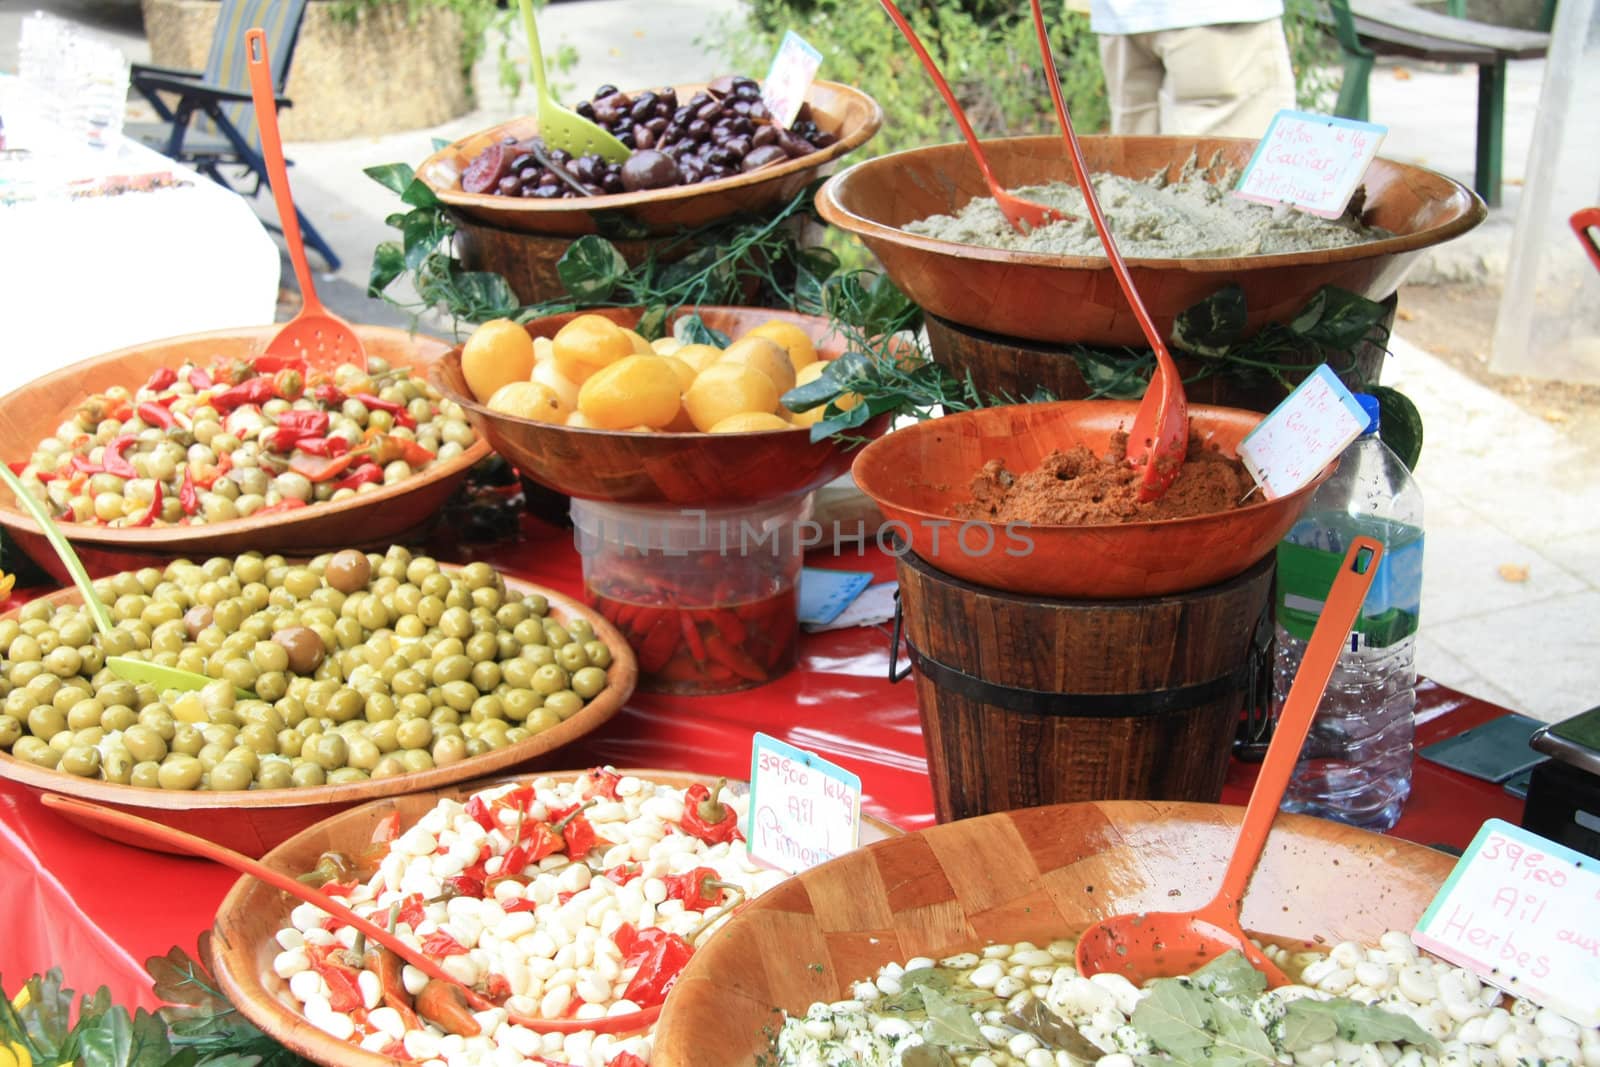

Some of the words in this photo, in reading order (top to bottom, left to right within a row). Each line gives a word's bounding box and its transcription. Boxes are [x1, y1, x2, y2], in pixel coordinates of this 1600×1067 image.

[1265, 144, 1334, 170] Caviar
[788, 796, 814, 825] Ail
[1492, 887, 1547, 924] Ail
[1442, 904, 1551, 978] Herbes
